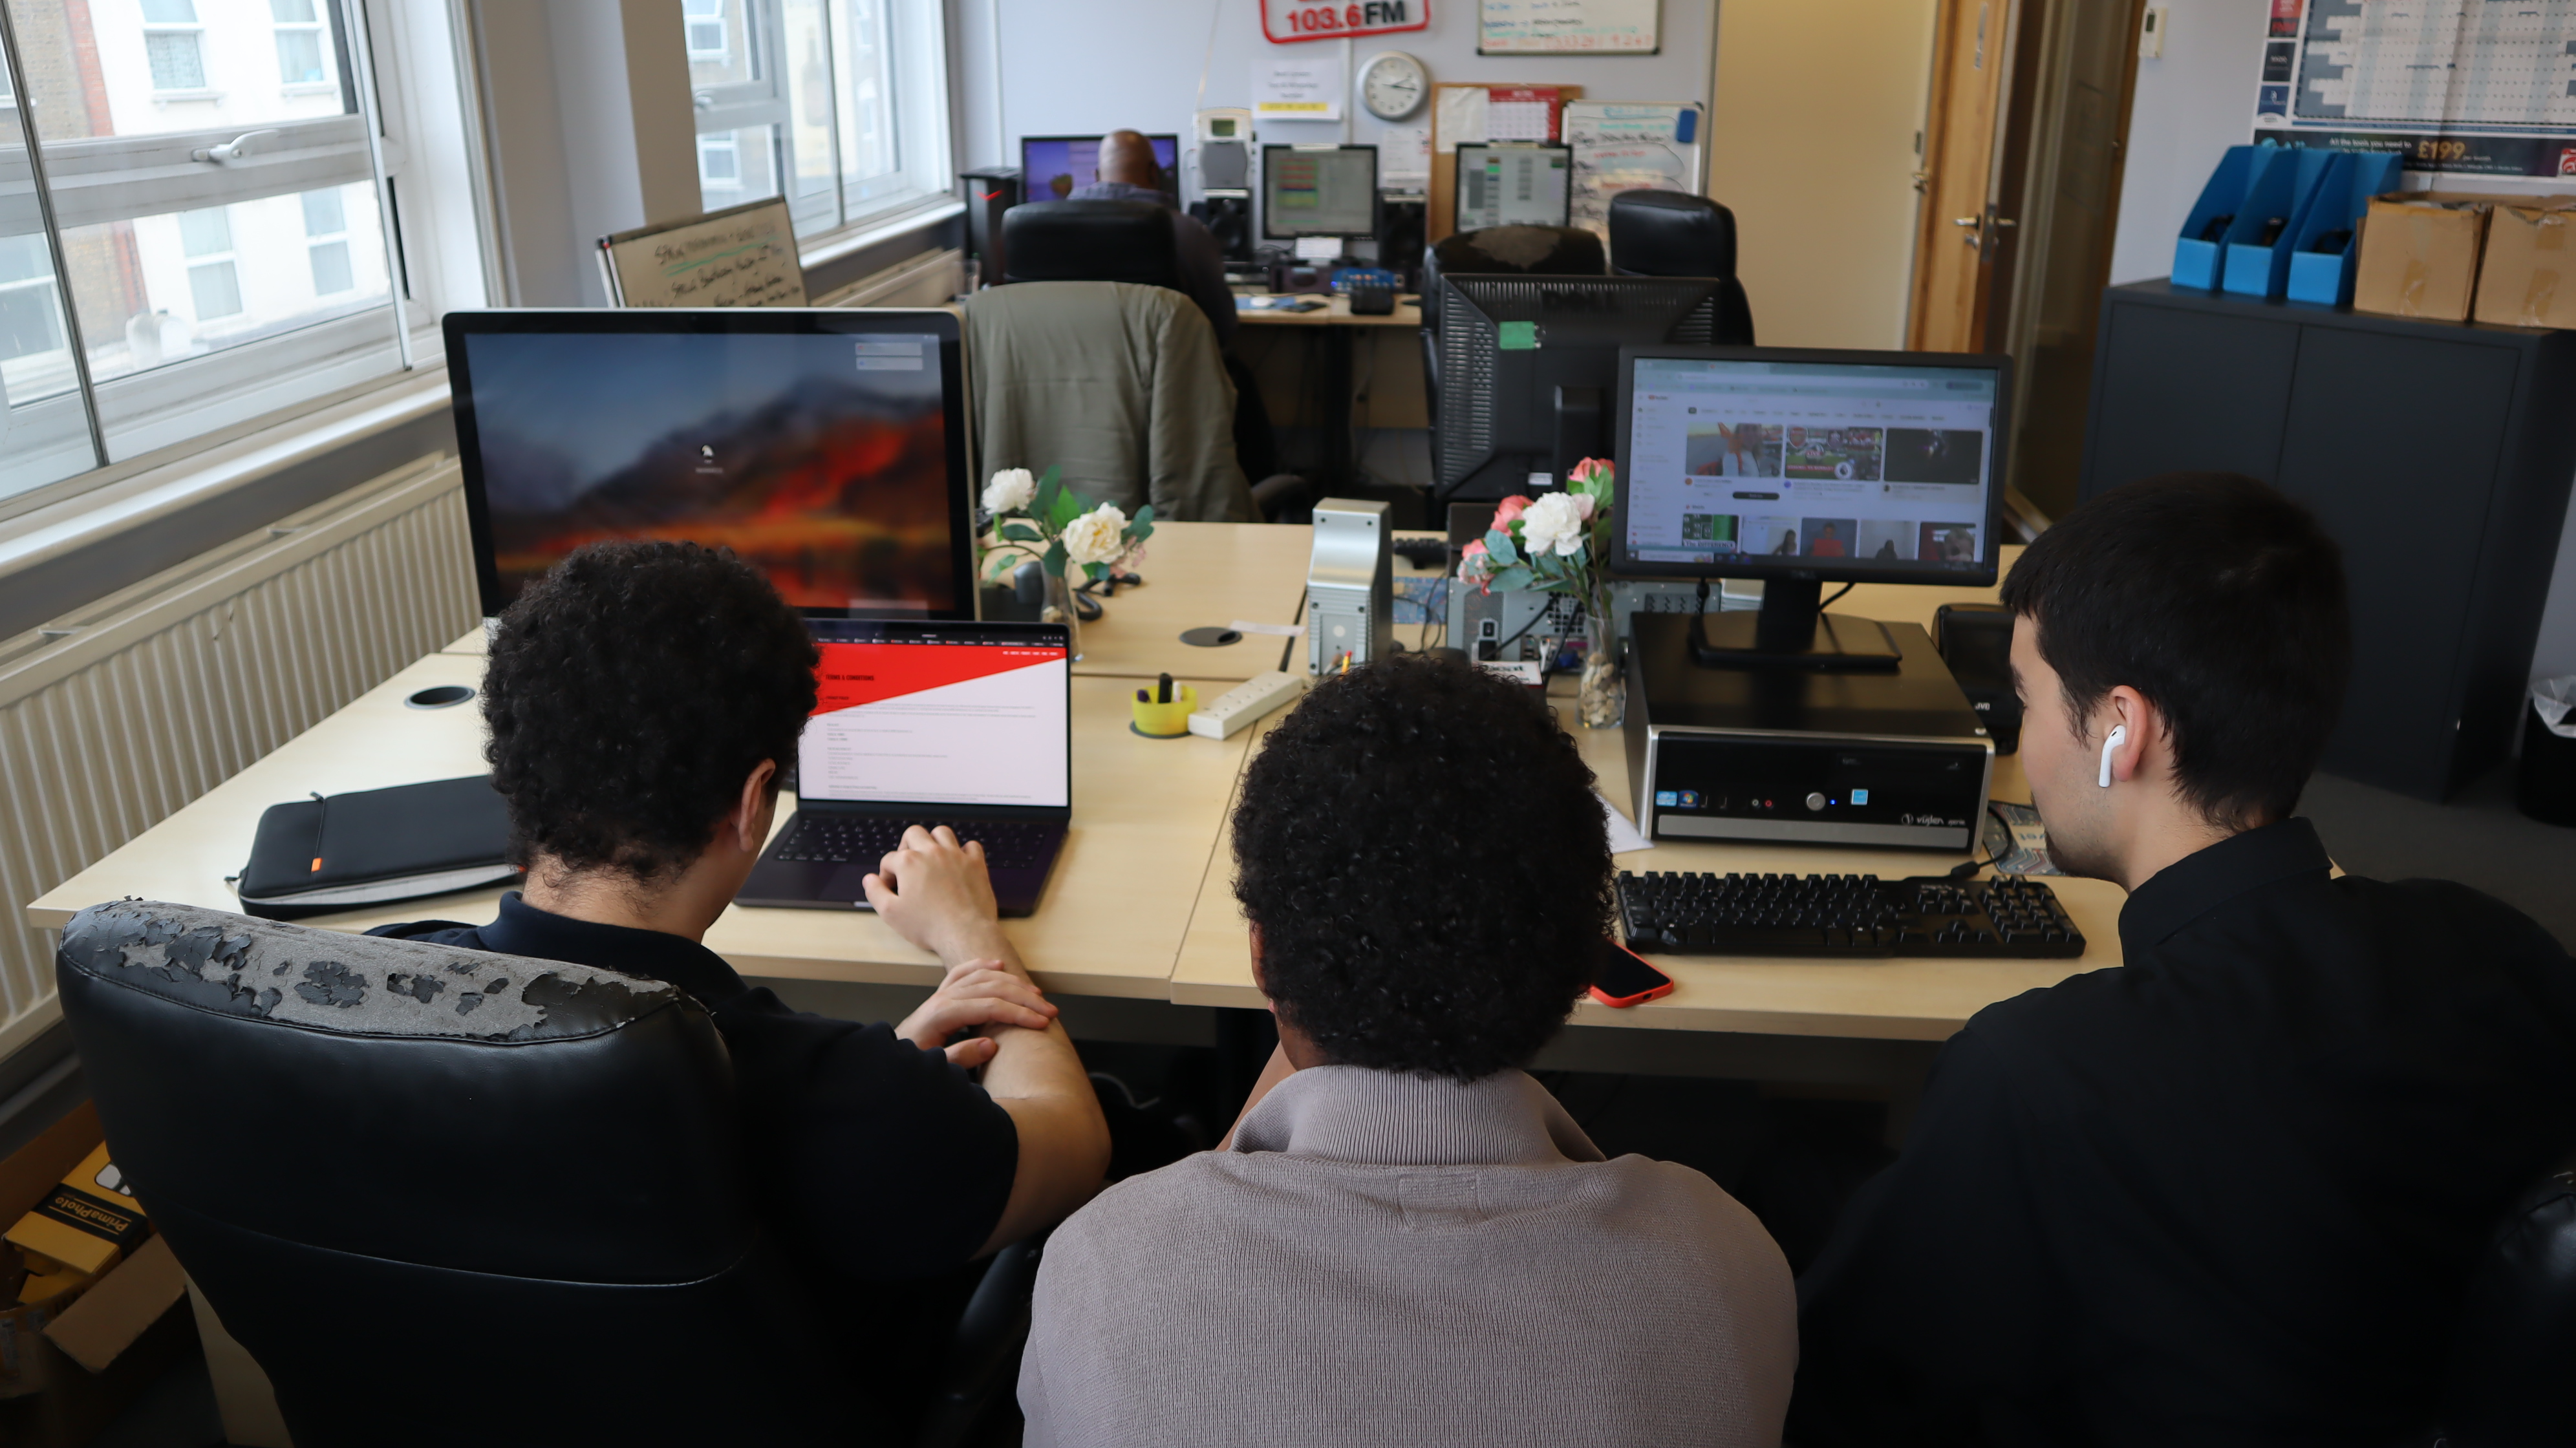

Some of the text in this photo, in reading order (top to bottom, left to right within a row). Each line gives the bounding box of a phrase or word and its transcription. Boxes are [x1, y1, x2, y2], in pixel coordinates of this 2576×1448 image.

[2340, 138, 2352, 146] the
[2417, 140, 2466, 160] £199
[1975, 702, 1990, 710] JVC
[54, 1197, 129, 1231] PrimaPhoto
